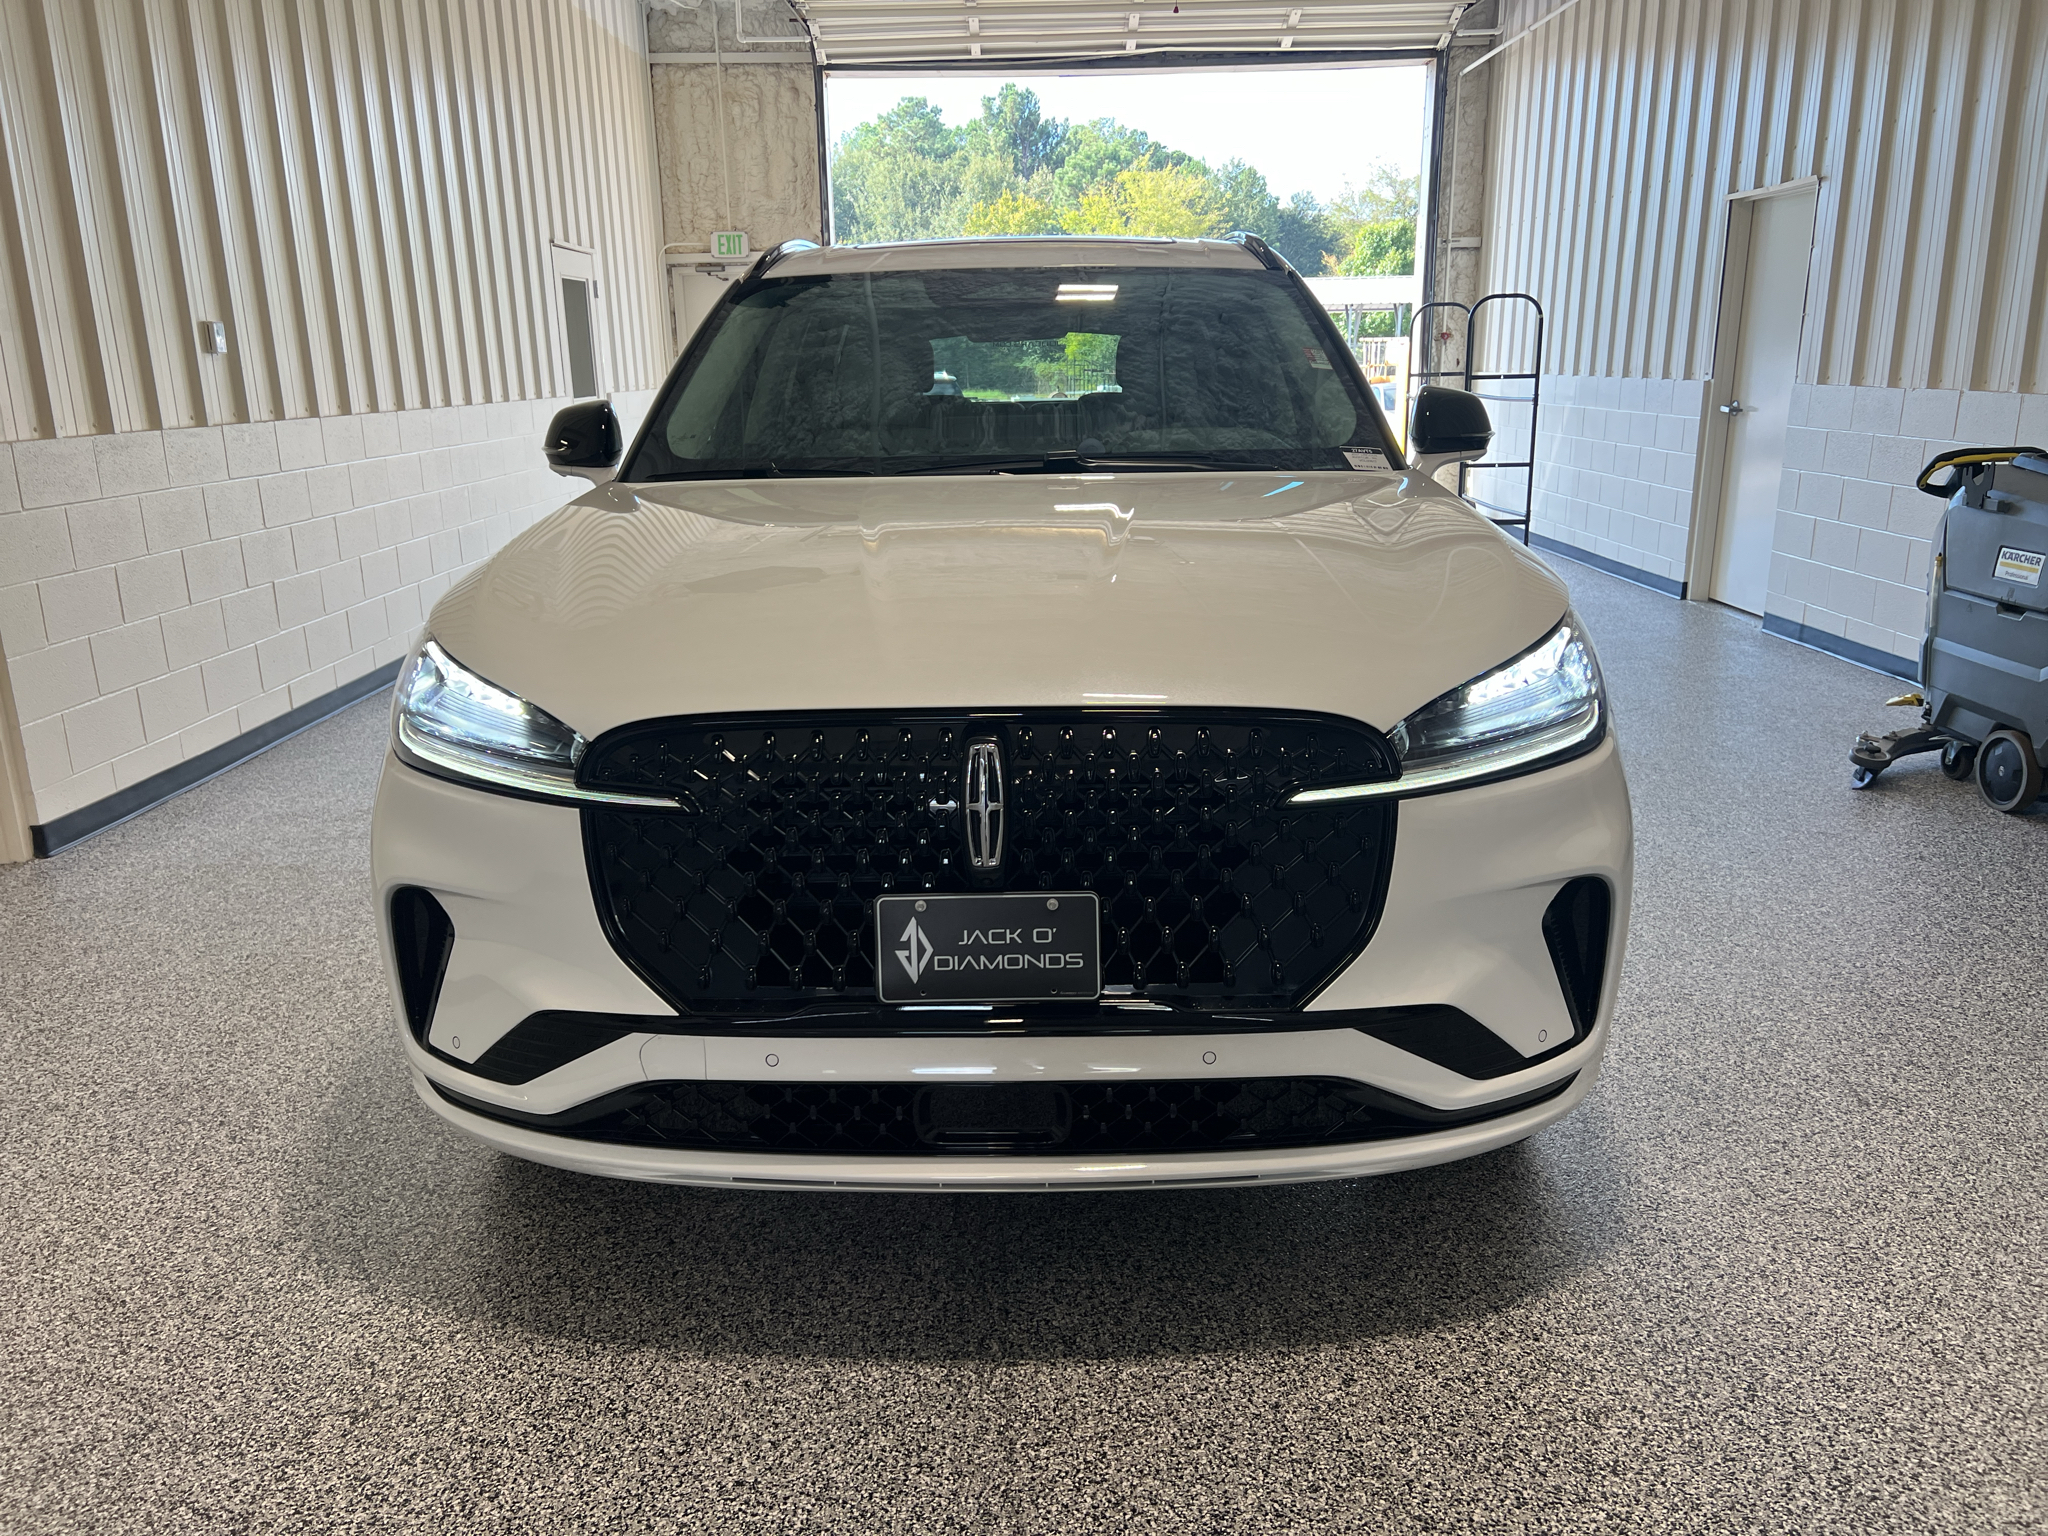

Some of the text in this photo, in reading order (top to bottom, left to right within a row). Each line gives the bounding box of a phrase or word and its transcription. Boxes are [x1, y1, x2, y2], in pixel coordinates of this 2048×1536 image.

[717, 234, 743, 255] EXIT
[2005, 571, 2029, 580] Professional
[958, 927, 1057, 945] JACK O'
[933, 953, 1084, 971] DIAMONDS
